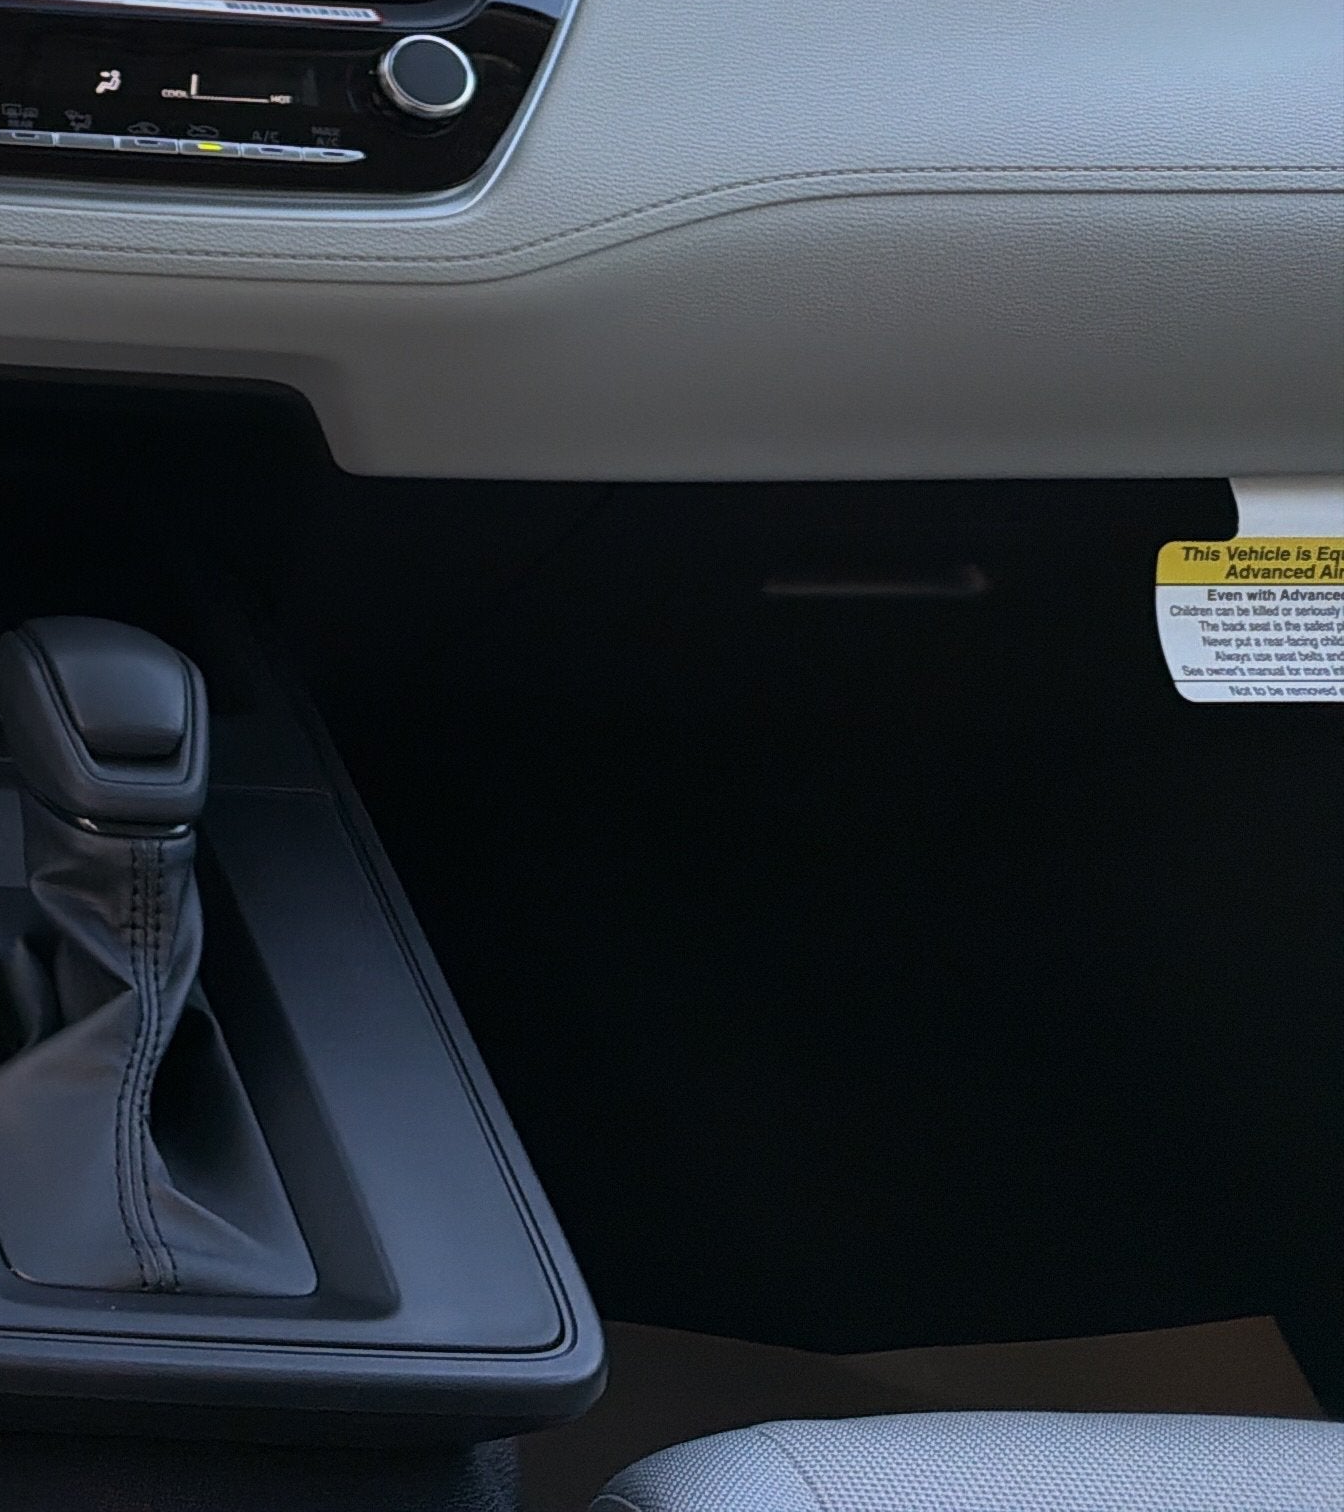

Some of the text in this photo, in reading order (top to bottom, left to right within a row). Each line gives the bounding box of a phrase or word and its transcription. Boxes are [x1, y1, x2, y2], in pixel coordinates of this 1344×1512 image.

[161, 88, 188, 99] COOL
[1182, 546, 1221, 562] This
[1226, 546, 1291, 562] Vehicle
[1296, 546, 1312, 562] is
[1225, 563, 1316, 580] Advanced
[1207, 589, 1243, 601] Even
[1246, 589, 1277, 601] with
[1169, 605, 1341, 619] Children can be killed or seriously
[1198, 620, 1220, 632] The
[1221, 620, 1246, 632] back
[1248, 621, 1271, 632] seat
[1273, 620, 1283, 632] is
[1284, 620, 1301, 632] the
[1303, 620, 1335, 632] safest
[1201, 636, 1233, 647] Never
[1234, 636, 1252, 649] put
[1253, 638, 1262, 647] a
[1262, 635, 1318, 649] rear-facing
[1215, 651, 1252, 664] Always
[1252, 653, 1272, 662] use
[1274, 652, 1297, 662] seat
[1181, 665, 1205, 676] See
[1205, 665, 1246, 676] owner's
[1246, 666, 1286, 677] manual
[1285, 665, 1301, 676] for
[1302, 667, 1331, 676] more
[1228, 686, 1252, 697] Not
[1252, 686, 1267, 696] to
[1266, 685, 1284, 697] be
[1284, 686, 1338, 697] removed
